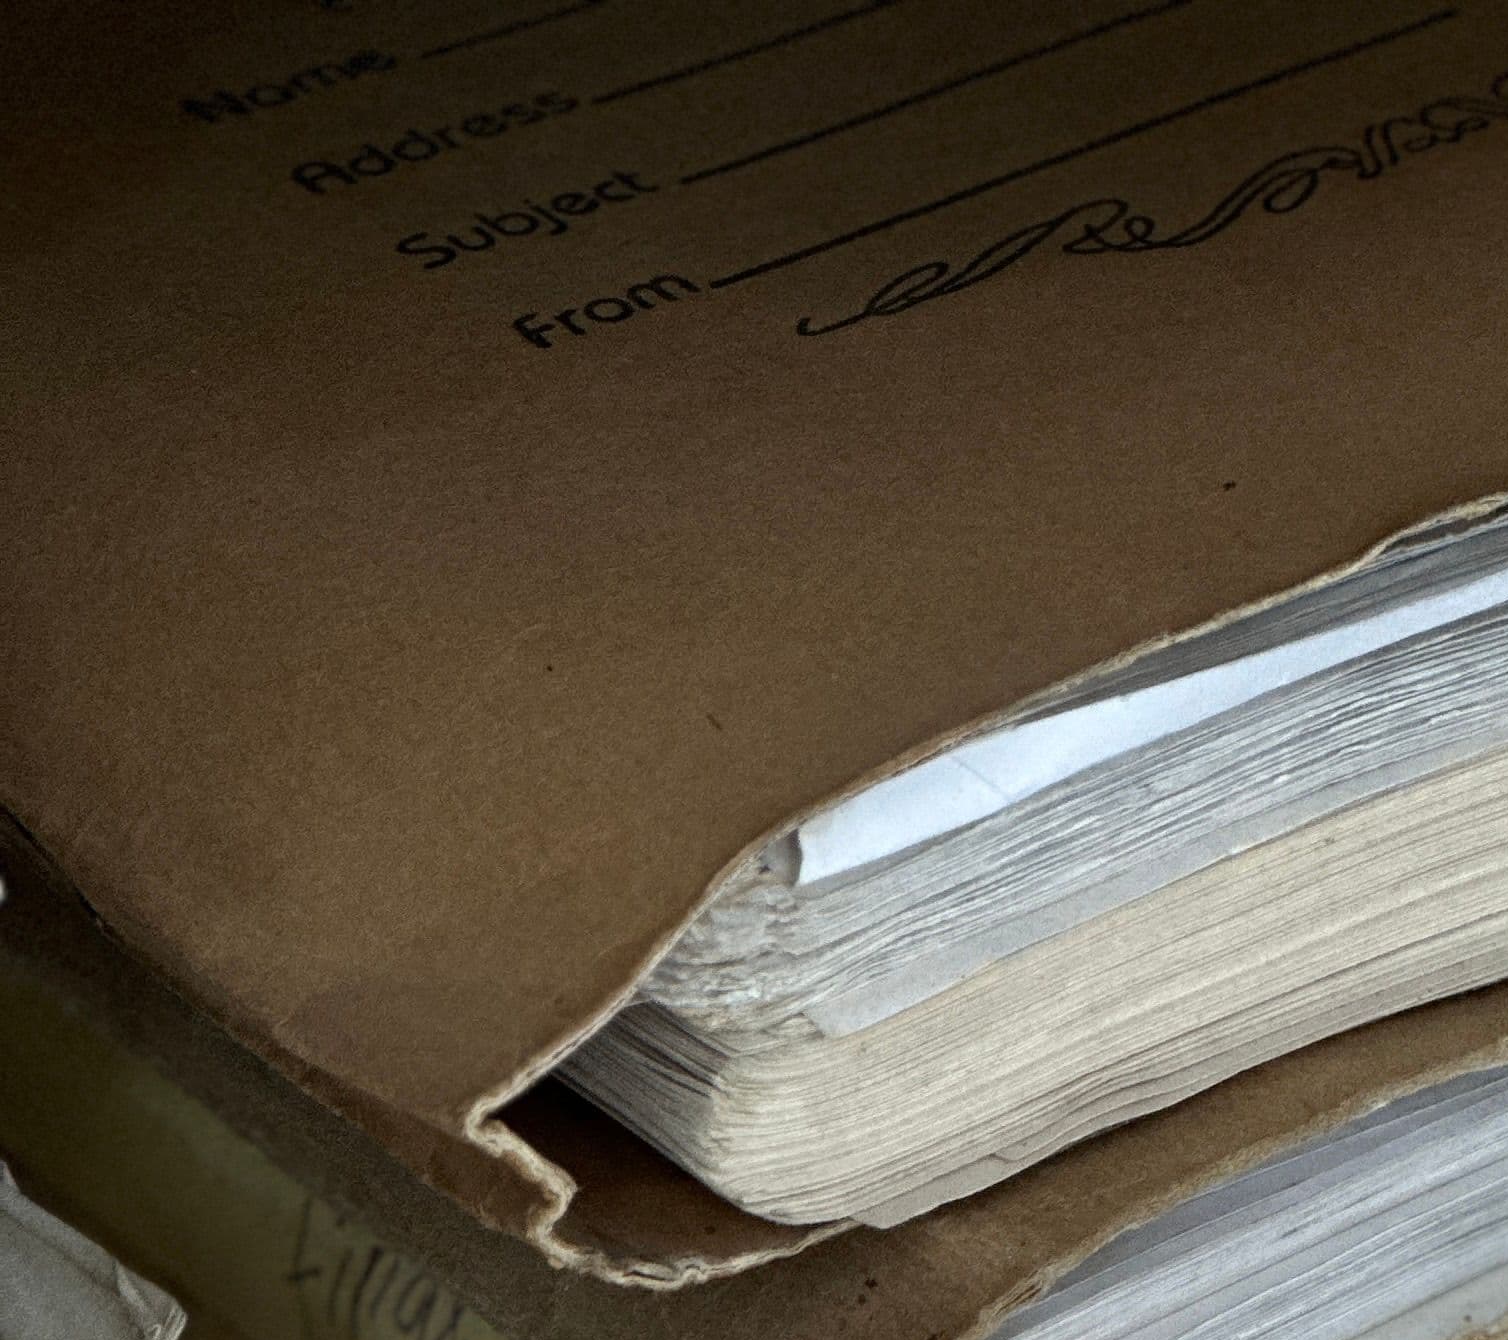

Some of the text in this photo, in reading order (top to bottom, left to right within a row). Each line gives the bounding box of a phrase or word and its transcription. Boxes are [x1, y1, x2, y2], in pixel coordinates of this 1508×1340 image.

[180, 50, 398, 125] Name
[290, 90, 579, 195] Address
[396, 170, 660, 270] Subject
[512, 271, 701, 350] From
